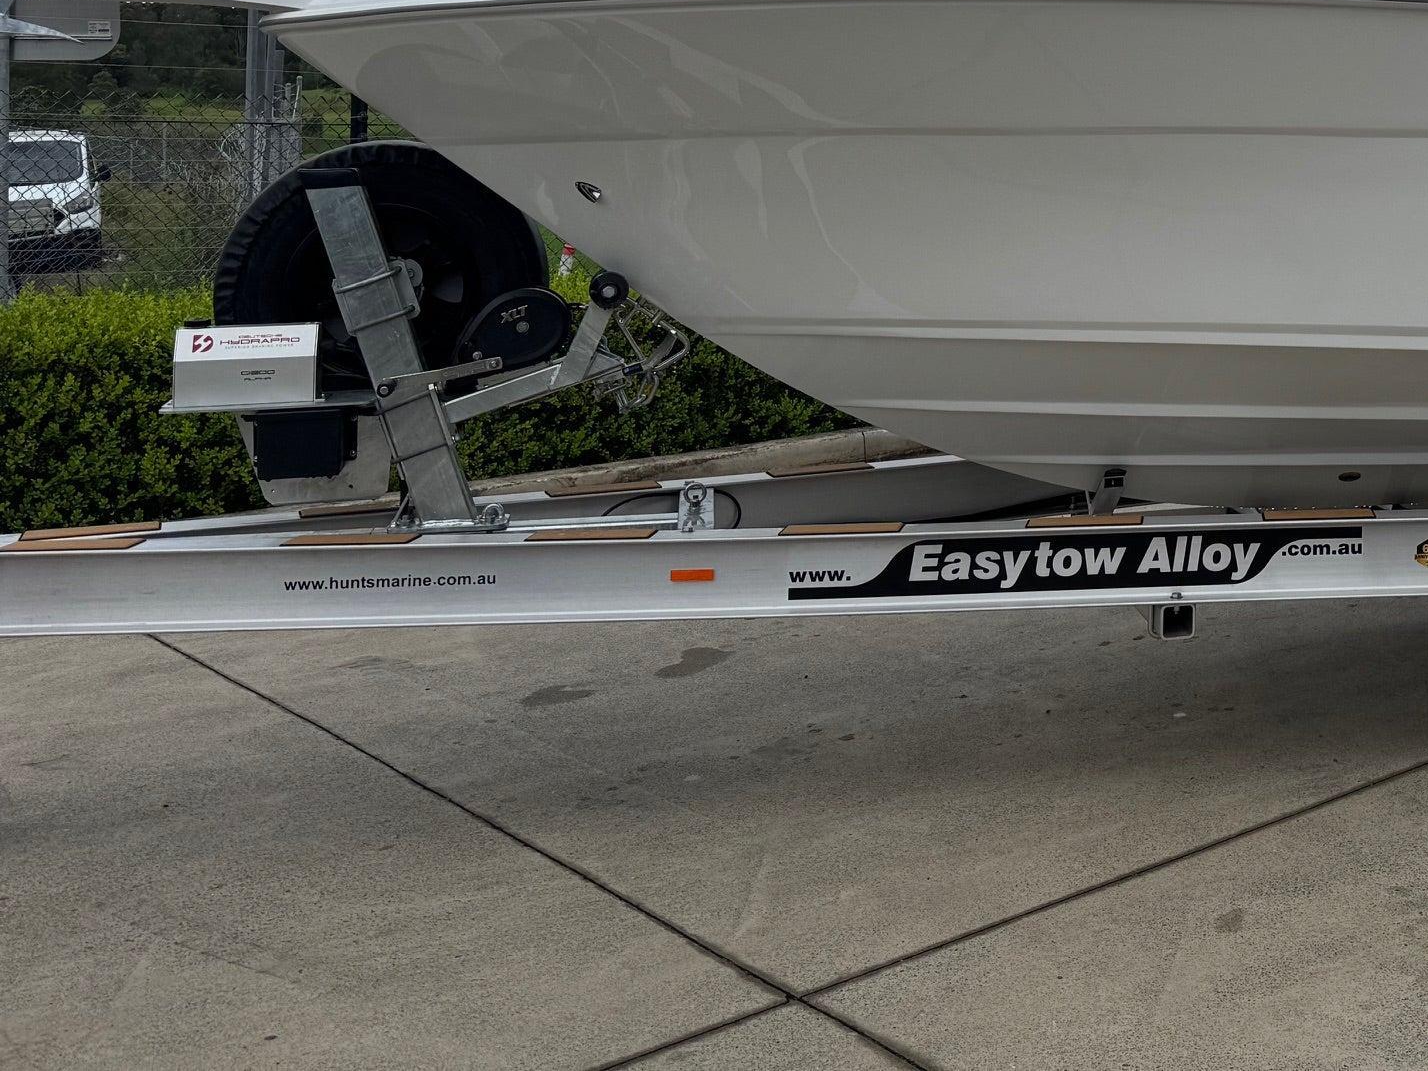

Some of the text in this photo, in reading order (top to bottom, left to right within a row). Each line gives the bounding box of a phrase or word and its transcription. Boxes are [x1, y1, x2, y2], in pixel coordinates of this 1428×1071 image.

[501, 305, 528, 324] XLT
[908, 541, 1127, 589] Easytow
[1136, 535, 1262, 580] Alloy
[1281, 542, 1363, 557] .com.au
[284, 574, 497, 591] www.huntsmarine.com.au
